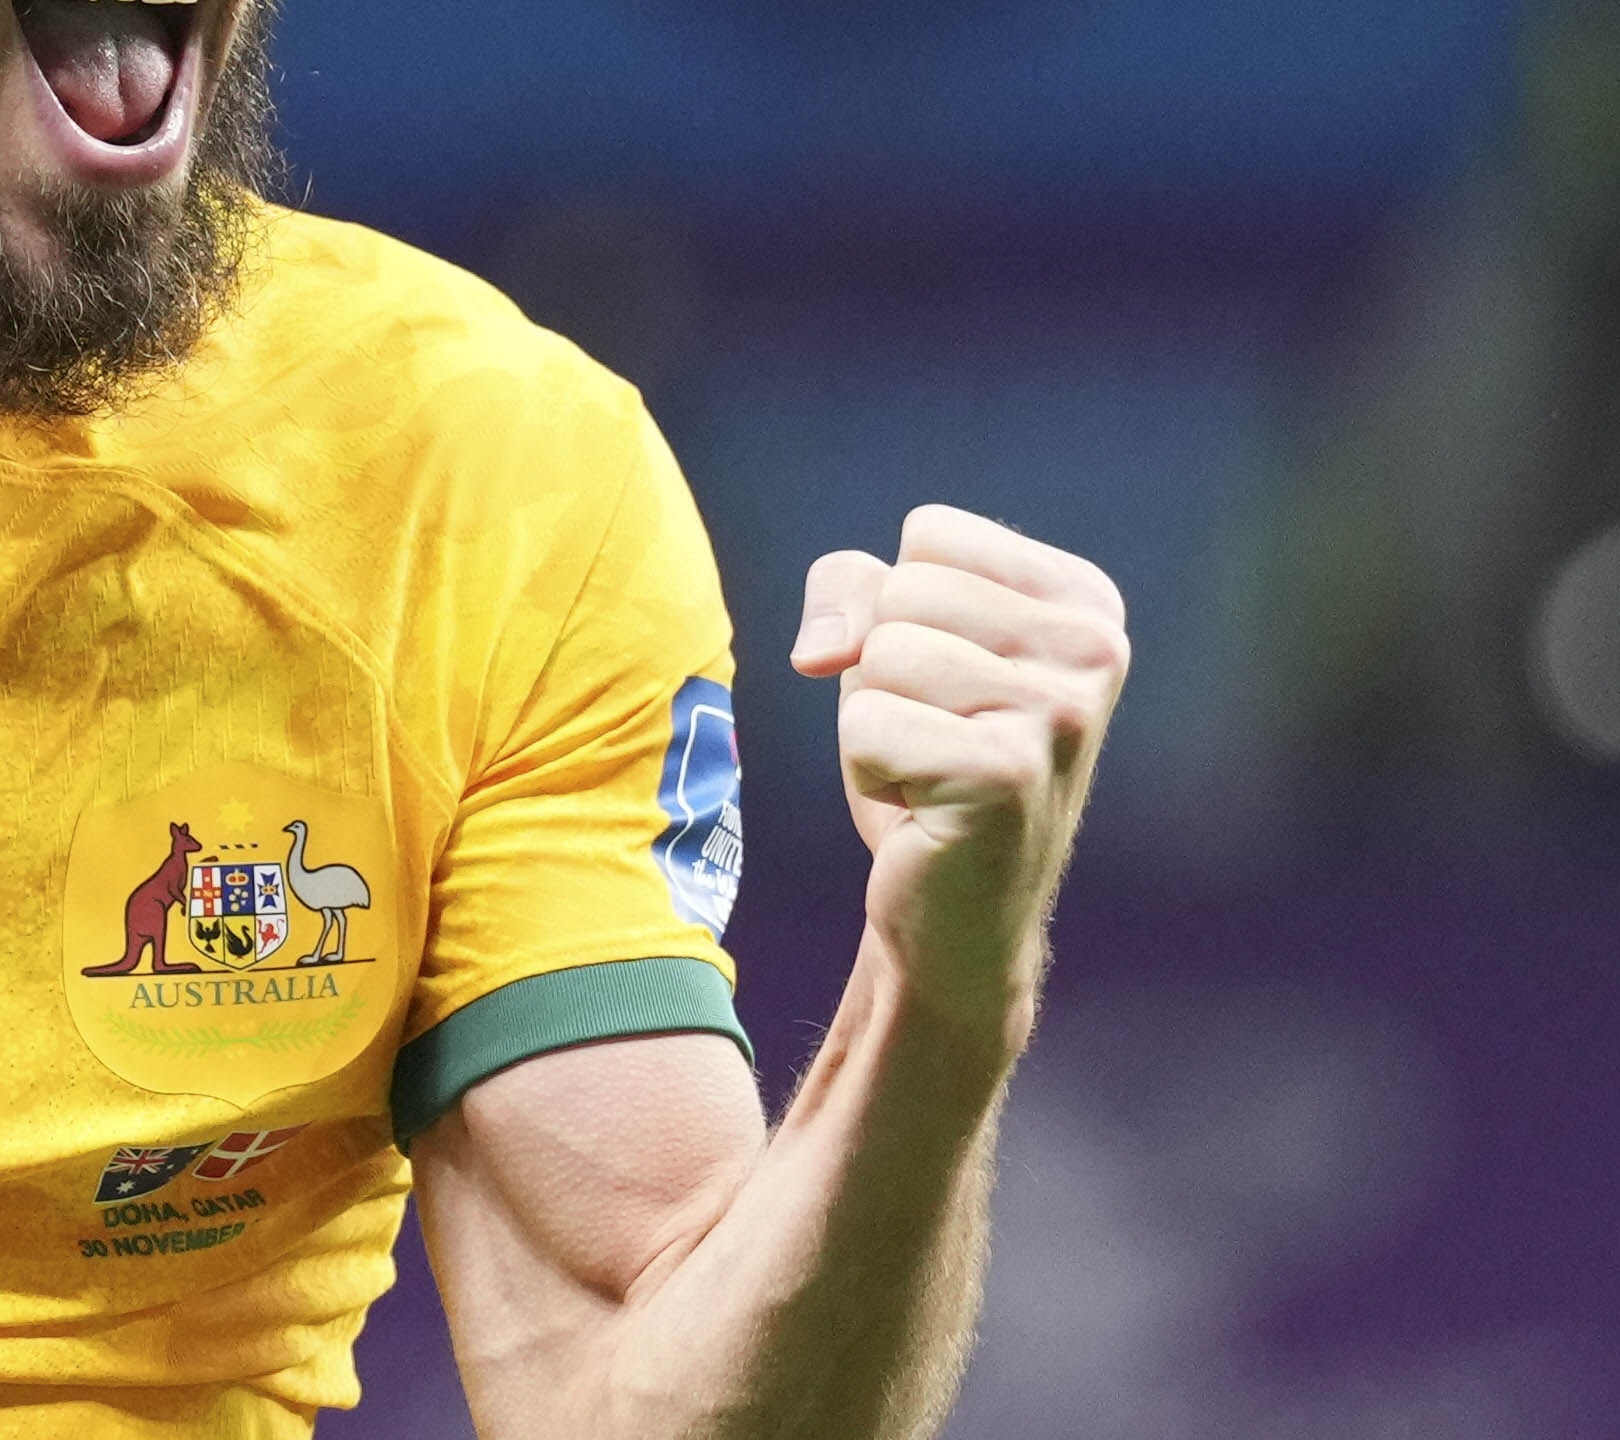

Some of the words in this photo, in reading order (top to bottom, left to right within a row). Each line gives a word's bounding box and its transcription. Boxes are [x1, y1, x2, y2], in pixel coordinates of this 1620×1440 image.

[129, 972, 339, 1009] AUSTRALIA
[78, 1238, 109, 1258] 30
[113, 1222, 246, 1258] NOVEMBER
